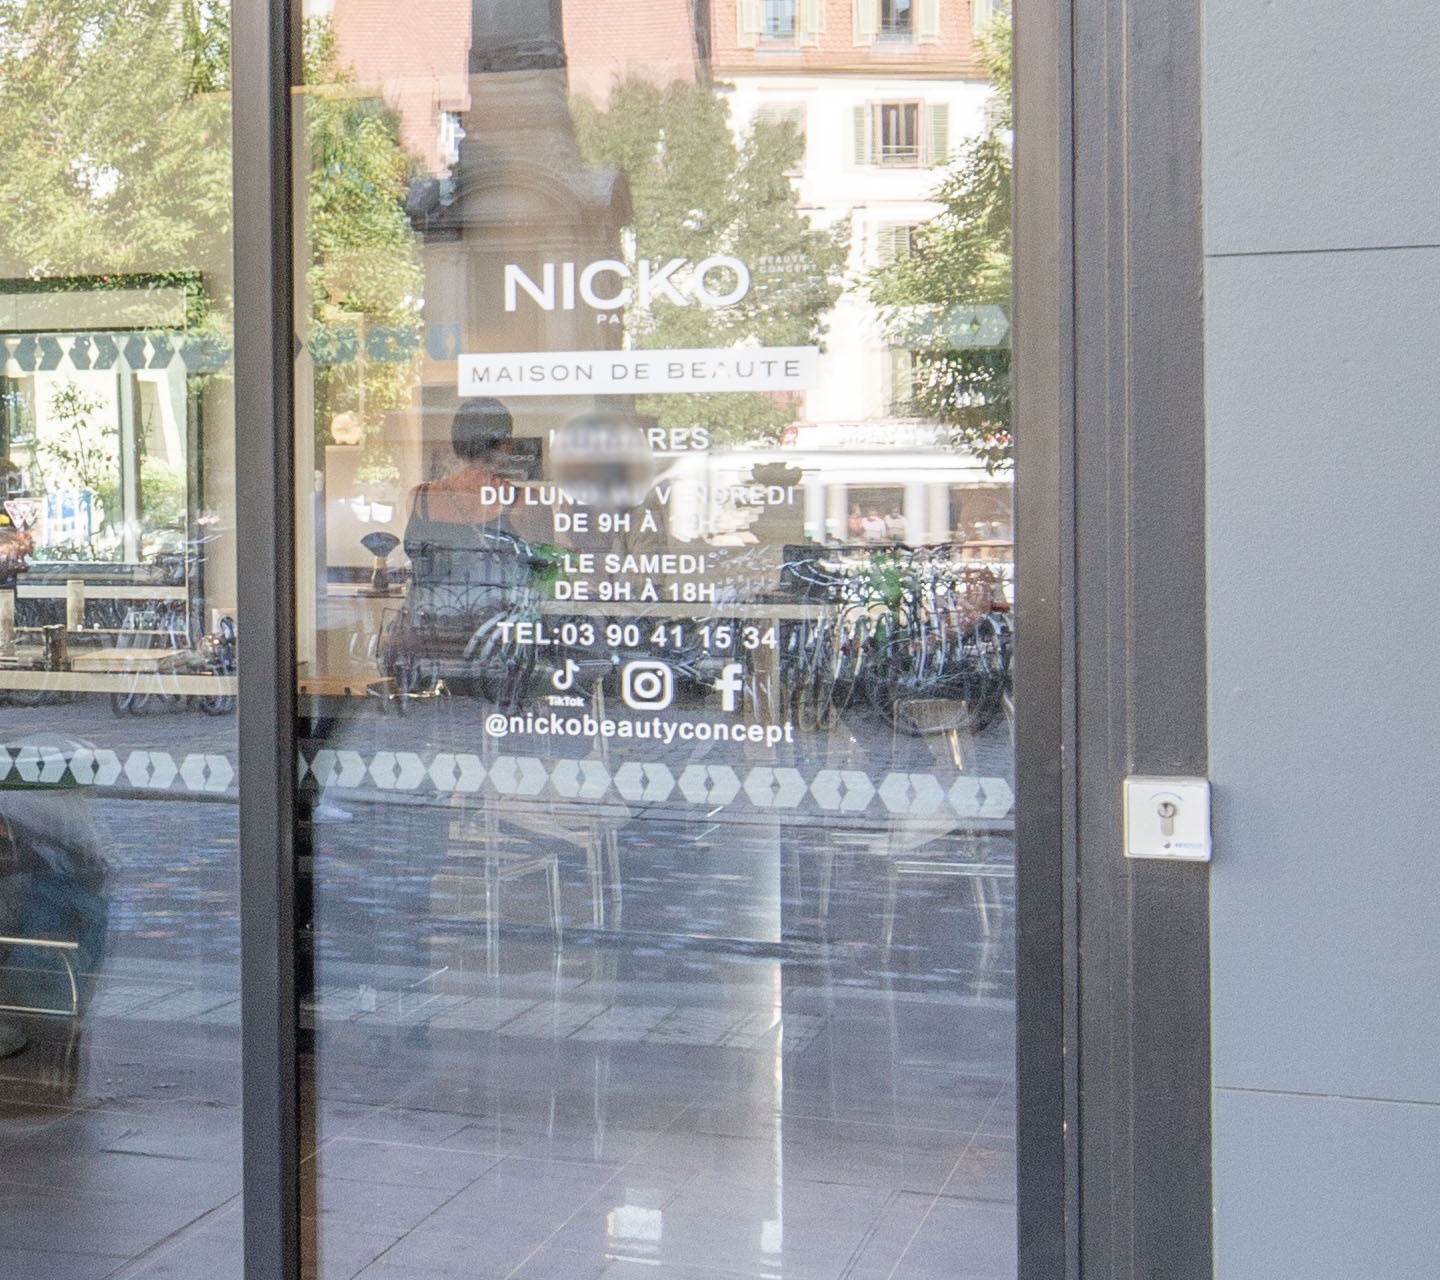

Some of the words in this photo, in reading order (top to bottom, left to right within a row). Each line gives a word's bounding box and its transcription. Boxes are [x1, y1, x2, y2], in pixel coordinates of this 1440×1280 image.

[504, 254, 750, 312] NICKO
[471, 365, 593, 384] MAISON
[611, 363, 650, 380] DE
[481, 486, 515, 505] DU
[655, 485, 794, 505] VNDREDI
[554, 513, 588, 532] DE
[598, 513, 630, 532] 9H
[639, 509, 658, 532] À
[565, 554, 595, 574] LE
[605, 553, 705, 574] SAMEDI
[554, 581, 590, 601] DE
[598, 581, 633, 601] 9H
[641, 576, 658, 601] À
[669, 581, 716, 601] 18H
[606, 624, 640, 646] 90
[650, 625, 684, 647] 41
[699, 626, 732, 649] 15
[741, 627, 778, 650] 34
[548, 696, 585, 707] TikTok
[484, 713, 794, 748] @nickobeautyconcept
